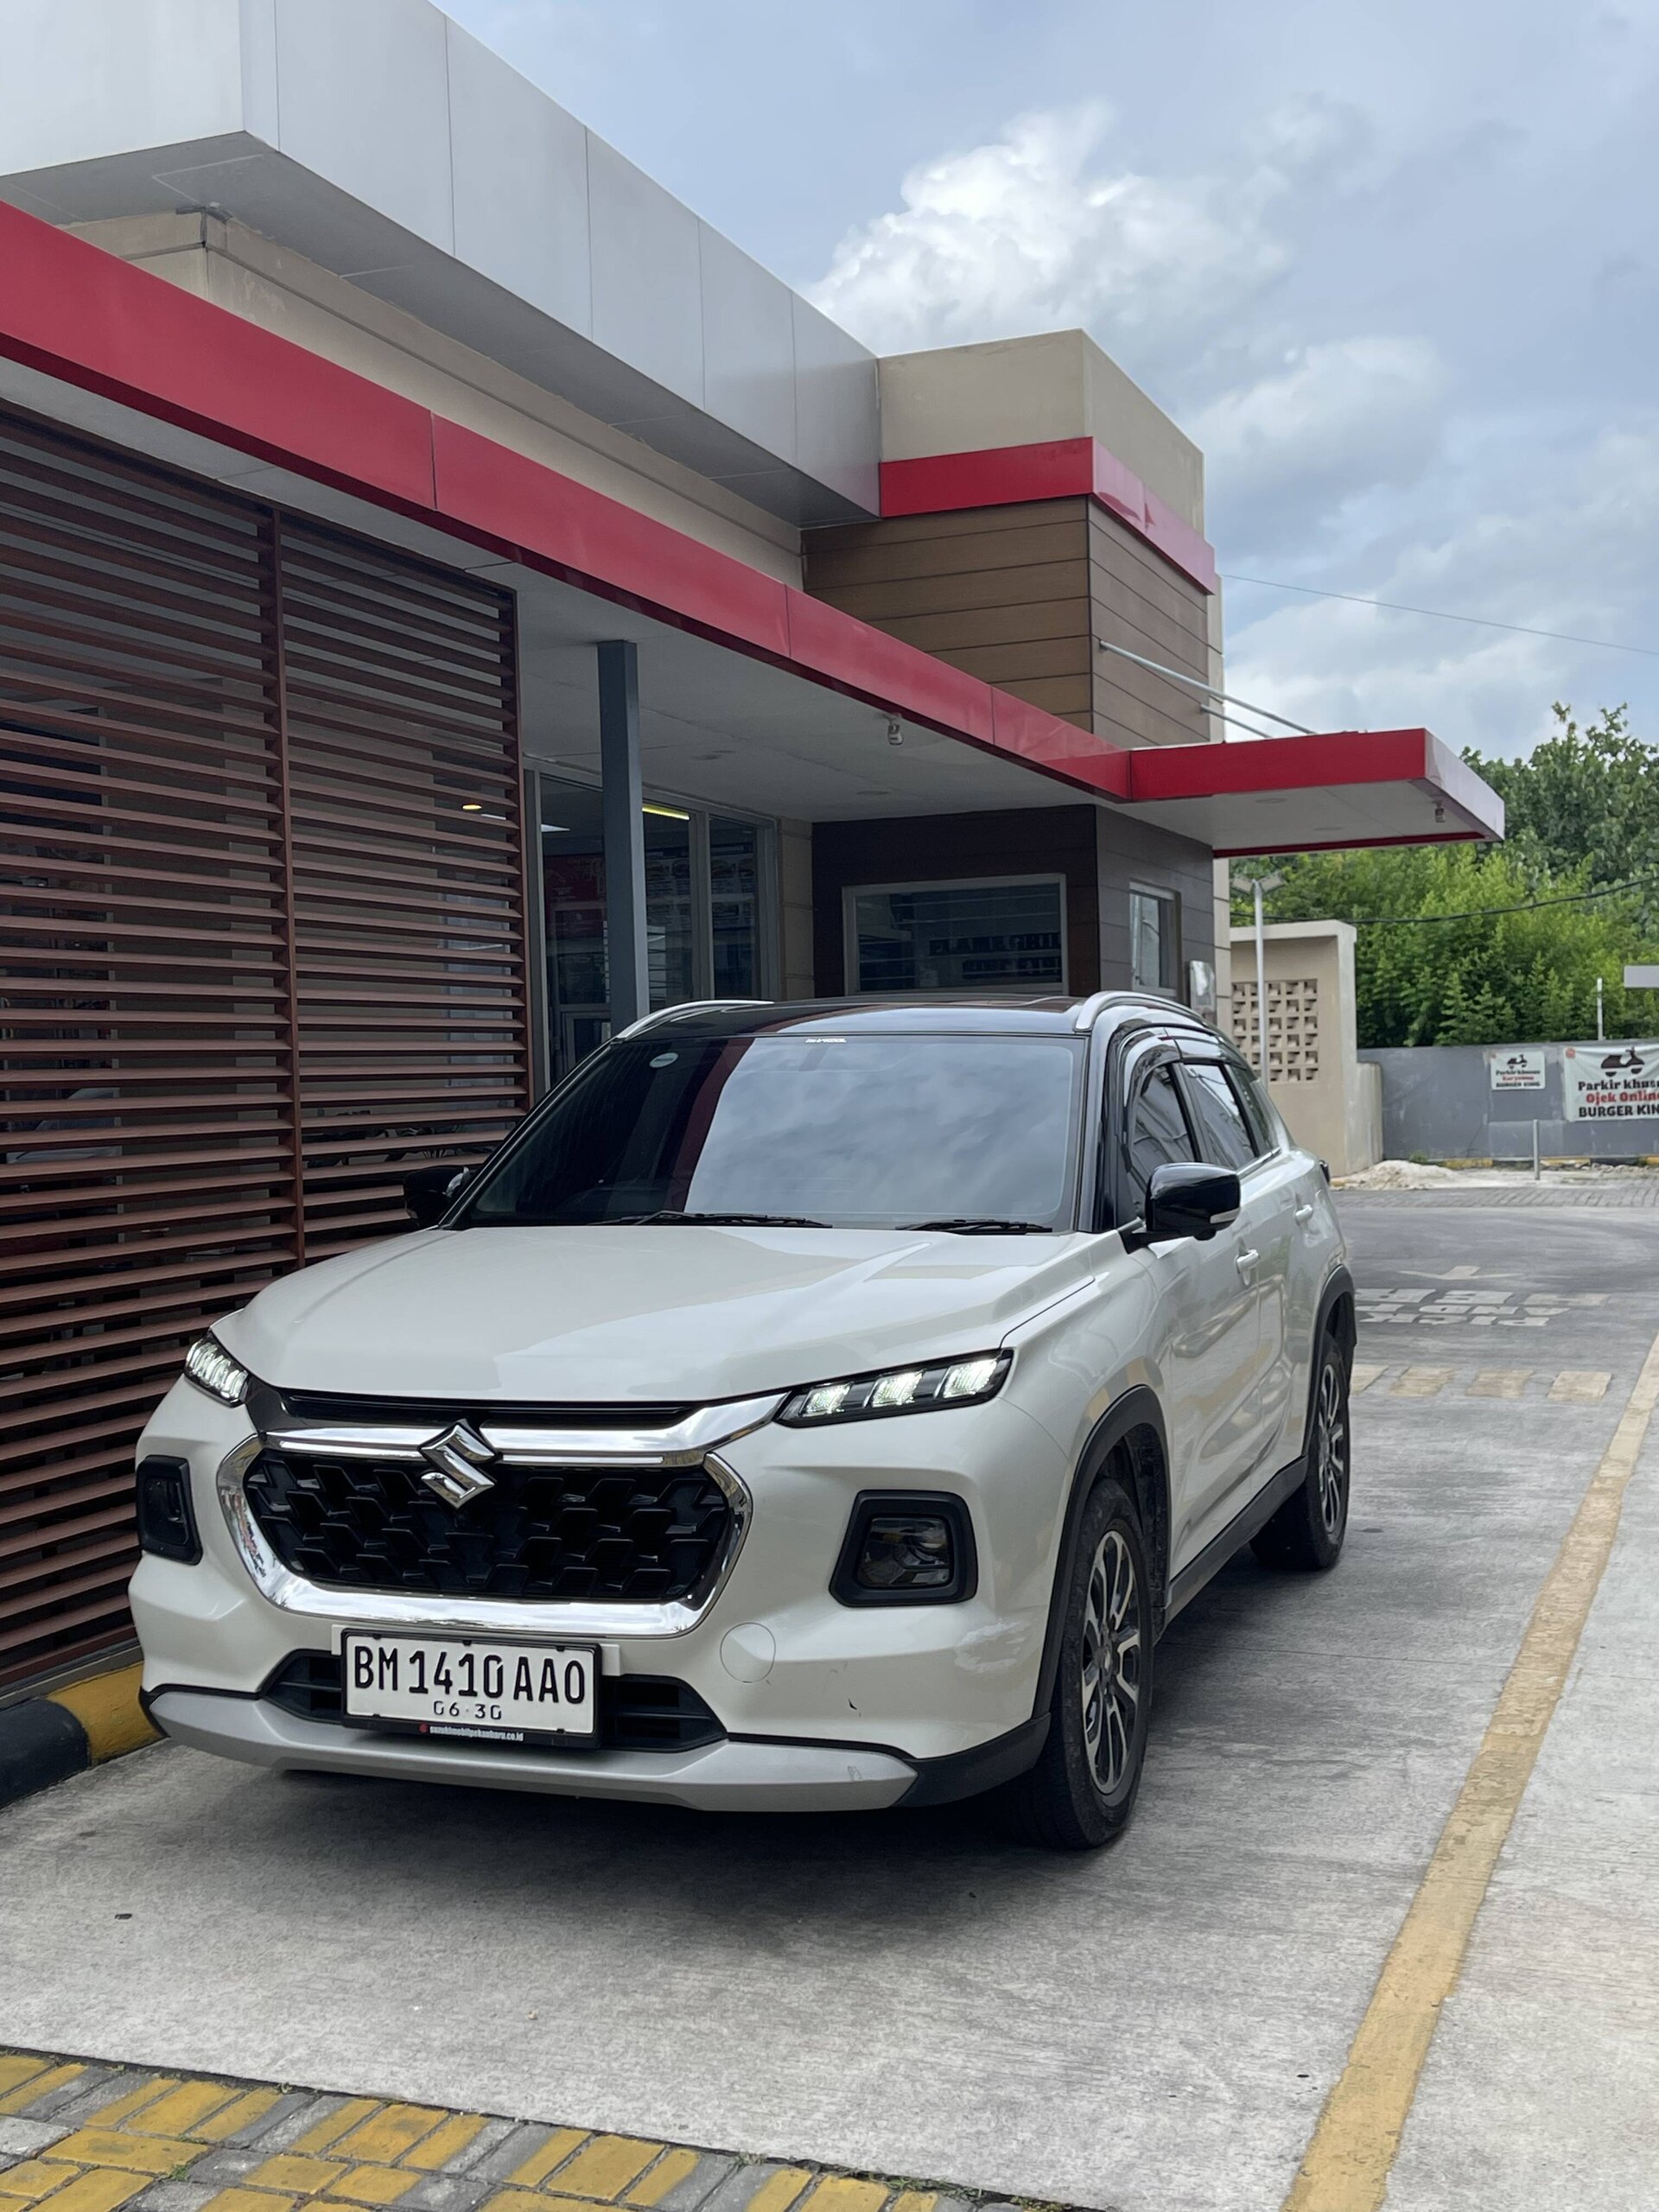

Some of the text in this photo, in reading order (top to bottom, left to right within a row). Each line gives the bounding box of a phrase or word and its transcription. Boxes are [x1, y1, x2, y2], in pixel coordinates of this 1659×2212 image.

[1578, 1078, 1659, 1091] Parkir khus
[1586, 1090, 1616, 1106] Ojek
[1579, 1103, 1659, 1117] BURGER KIN
[354, 1646, 399, 1691] BM
[408, 1650, 504, 1699] 1410
